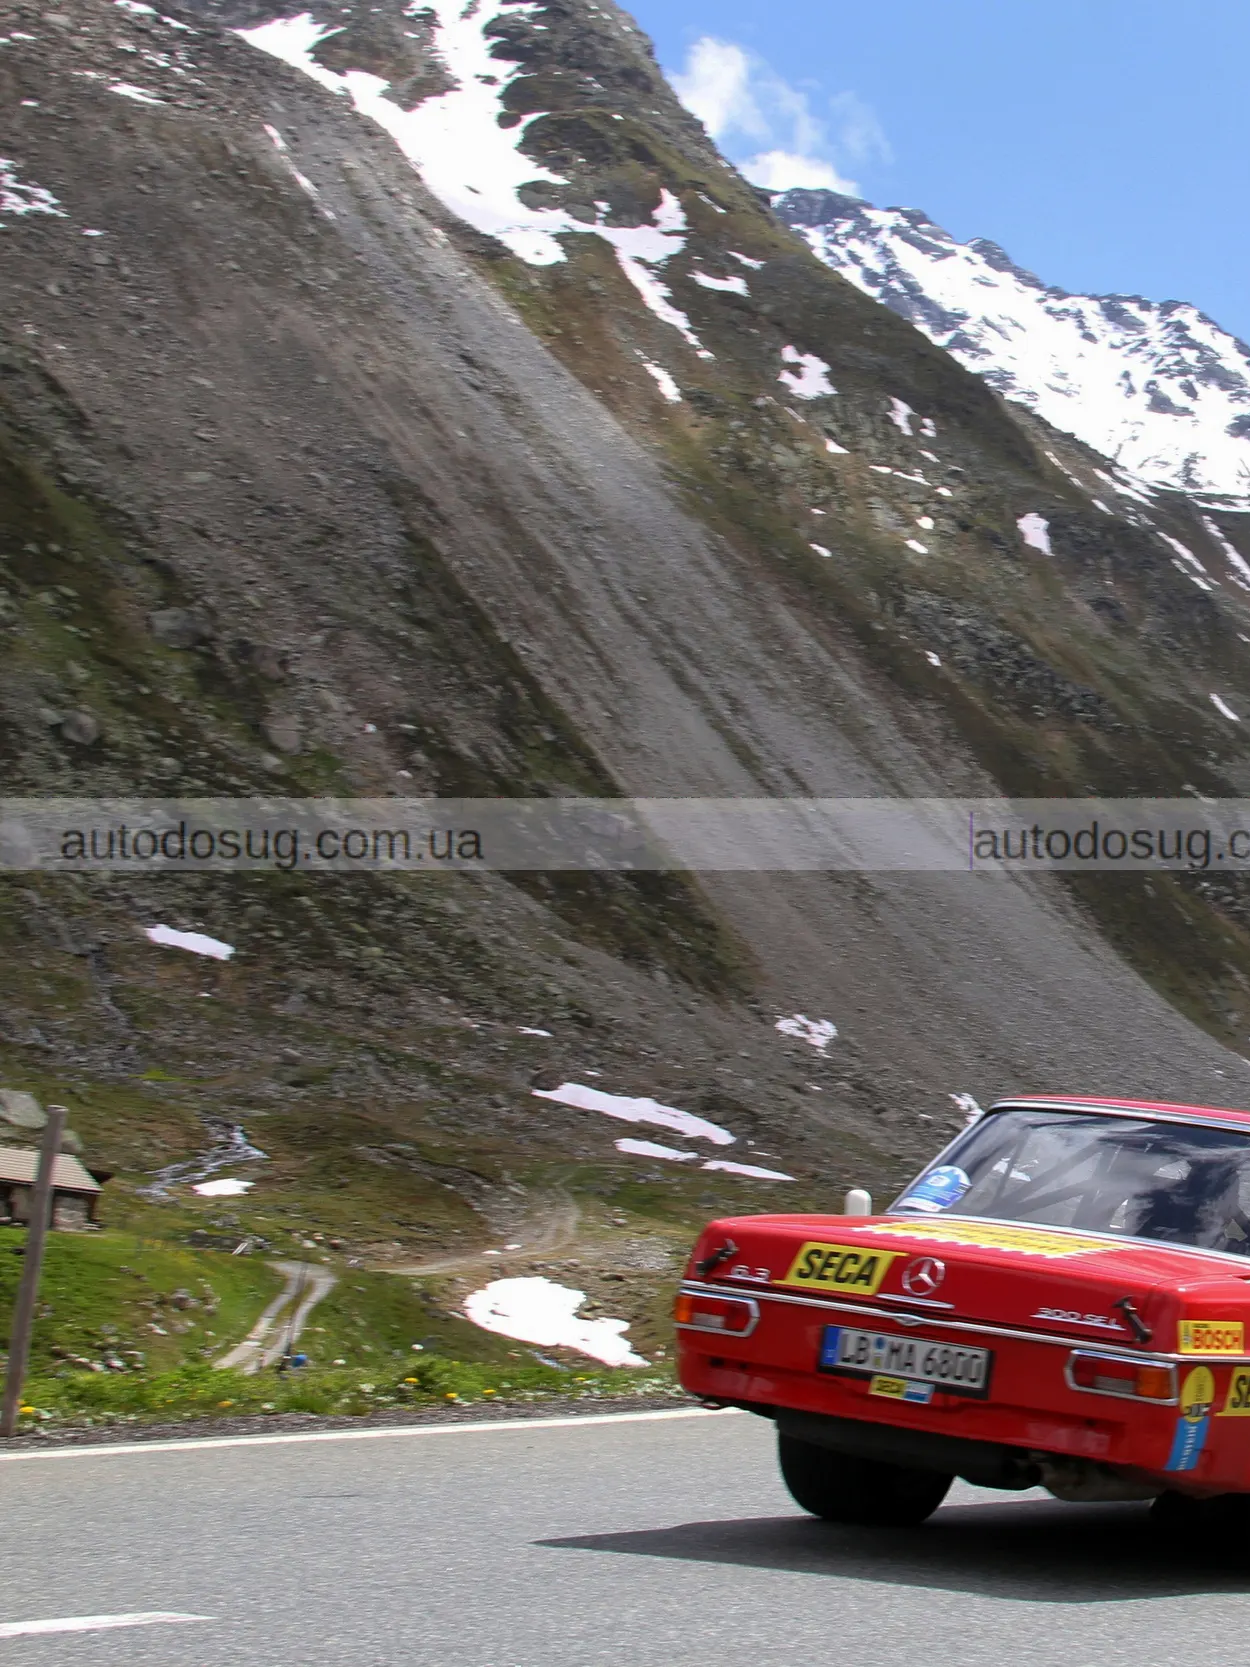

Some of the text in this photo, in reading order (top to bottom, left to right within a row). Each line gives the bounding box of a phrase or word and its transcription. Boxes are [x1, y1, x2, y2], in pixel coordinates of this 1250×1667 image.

[797, 1249, 881, 1286] SECA
[1193, 1328, 1241, 1350] BOSCH
[923, 1347, 985, 1383] 6800
